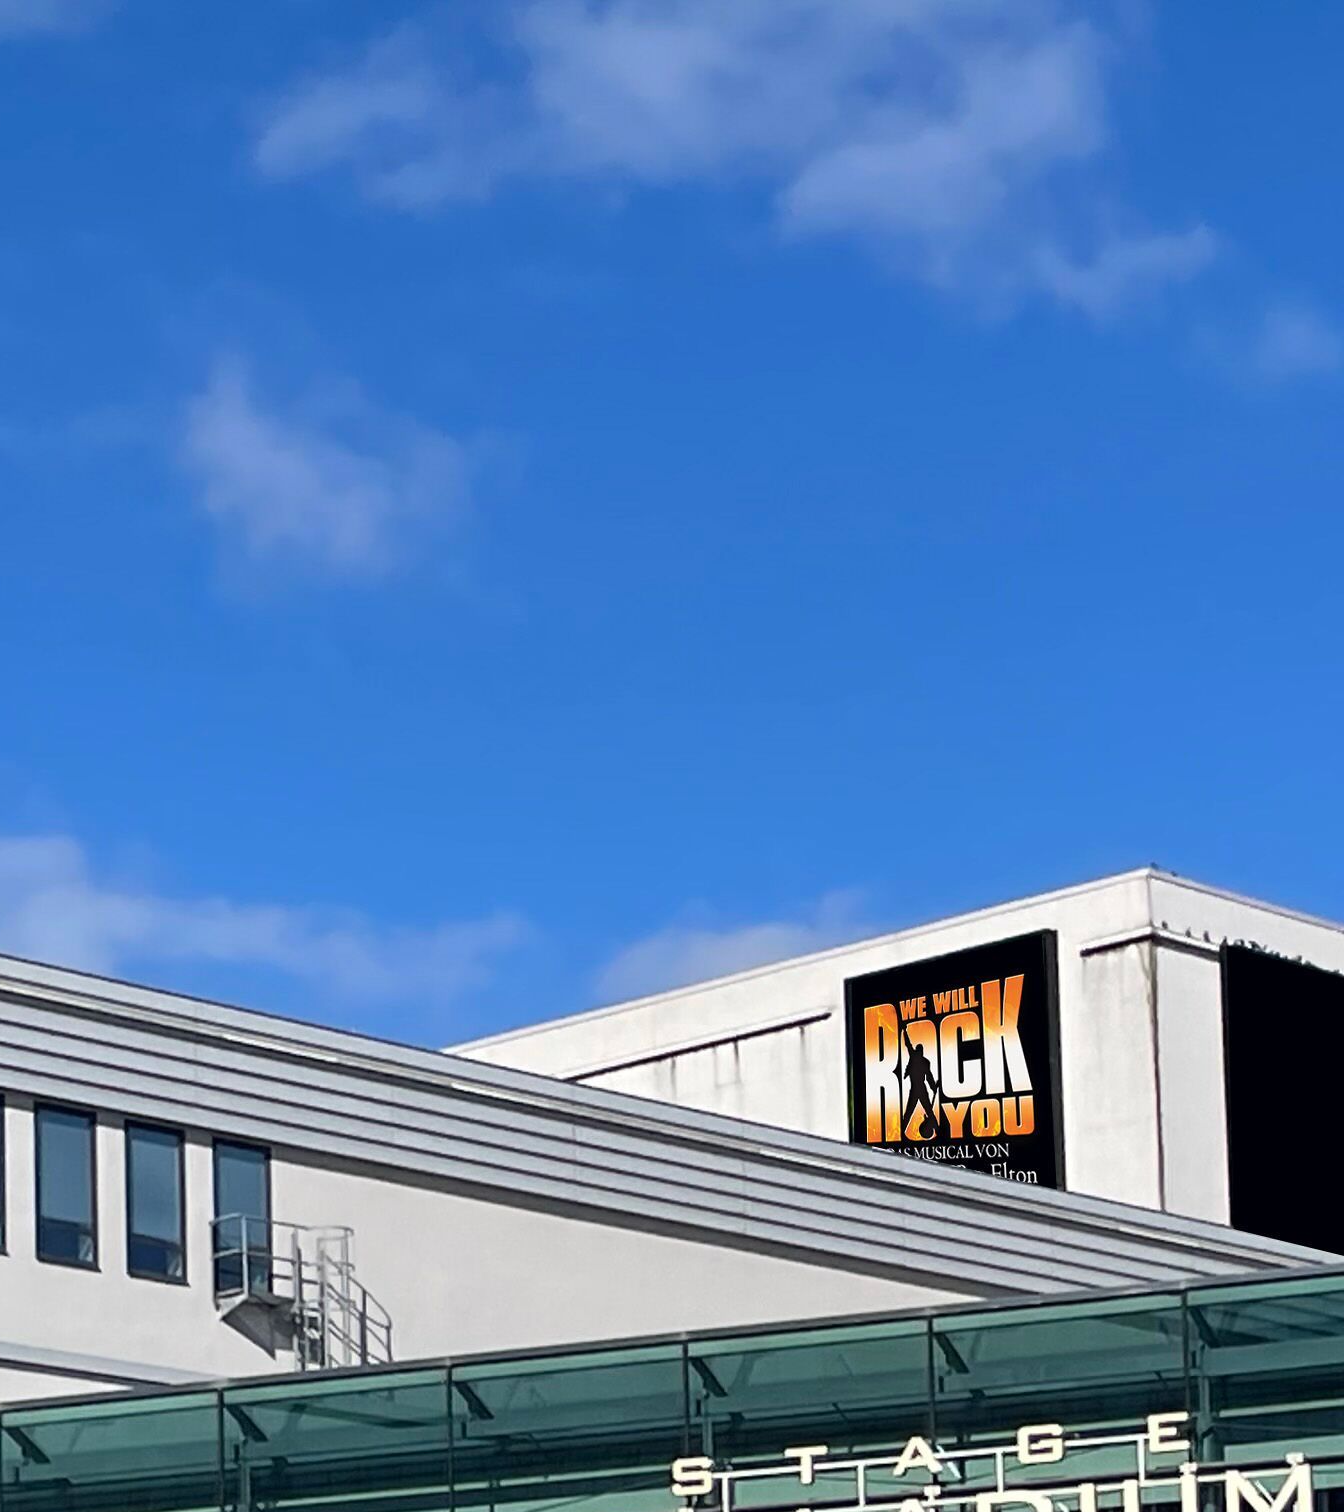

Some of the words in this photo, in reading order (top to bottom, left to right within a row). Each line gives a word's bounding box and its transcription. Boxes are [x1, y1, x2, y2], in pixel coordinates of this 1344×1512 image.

[899, 996, 927, 1021] WE
[932, 985, 979, 1015] WILL
[863, 973, 1033, 1143] ROCK
[941, 1094, 1035, 1139] YOU
[914, 1145, 973, 1160] MUSICAL
[976, 1143, 1010, 1158] VON
[671, 1411, 1192, 1496] STAGE
